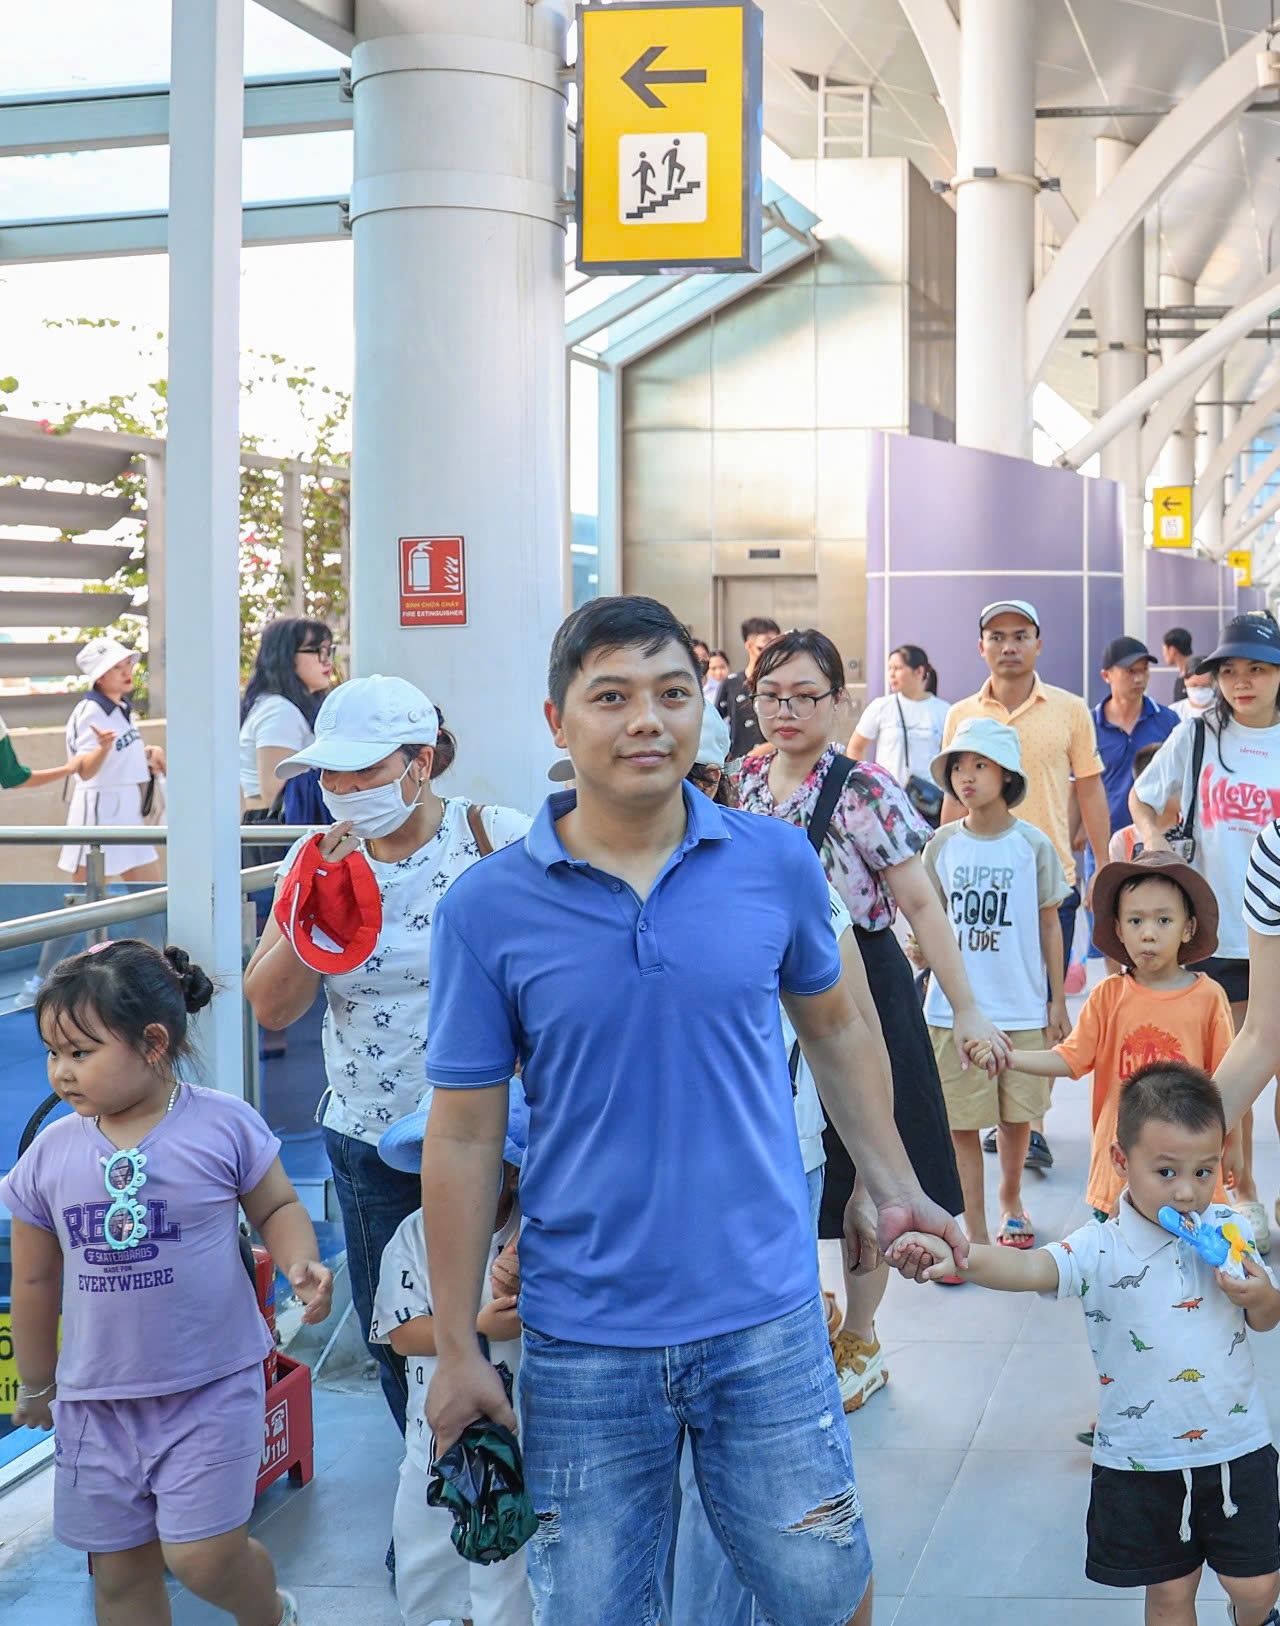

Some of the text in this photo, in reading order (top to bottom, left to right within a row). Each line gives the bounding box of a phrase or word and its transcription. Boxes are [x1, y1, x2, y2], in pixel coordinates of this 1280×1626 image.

[953, 866, 1014, 889] SUPER
[951, 890, 1013, 927] COOL
[62, 1199, 181, 1250] REL
[96, 1246, 152, 1262] SKATEBOARDS
[79, 1268, 174, 1293] EVERYWHERE
[271, 1437, 287, 1461] 114
